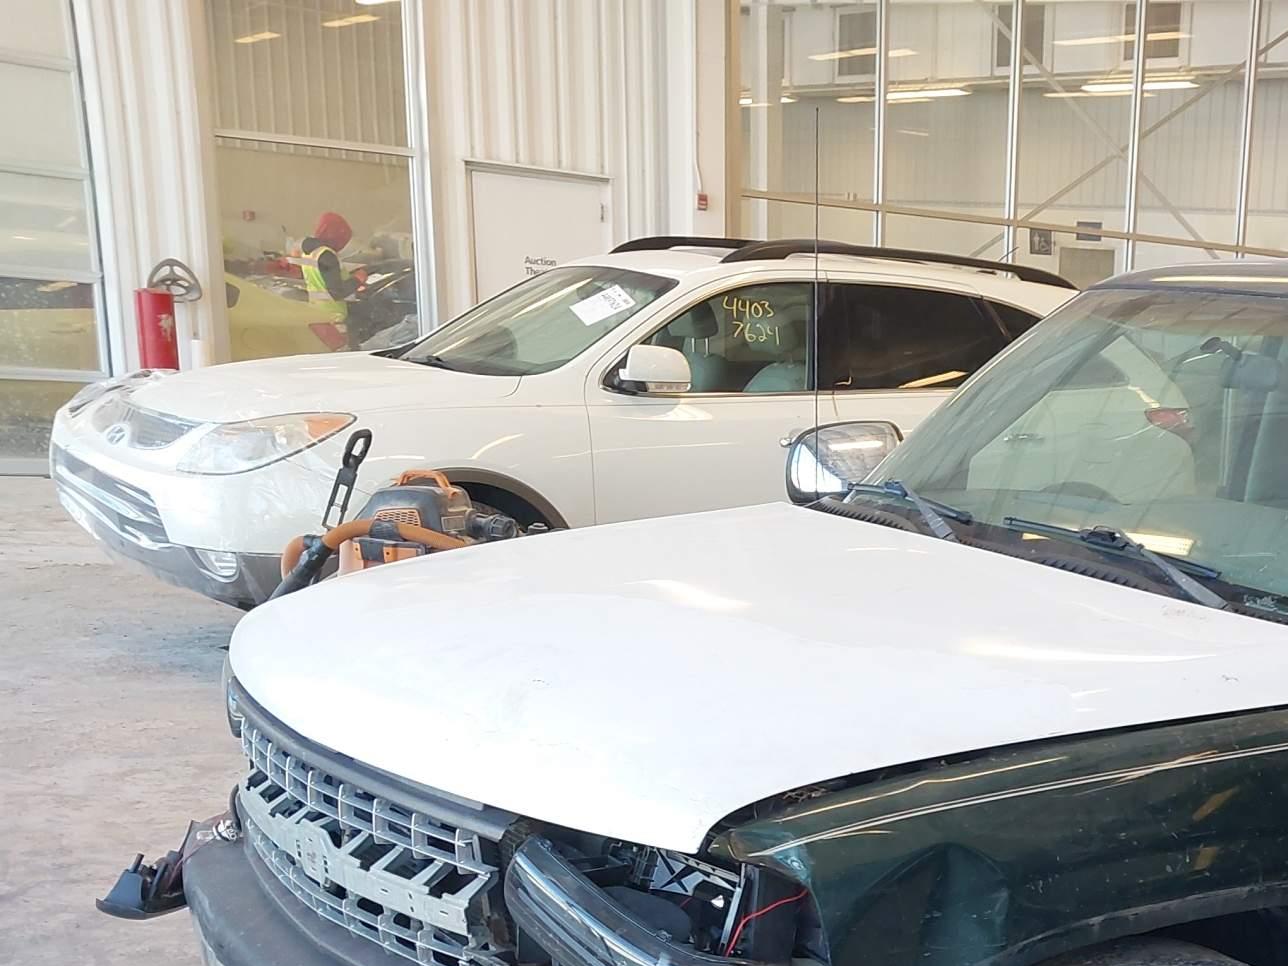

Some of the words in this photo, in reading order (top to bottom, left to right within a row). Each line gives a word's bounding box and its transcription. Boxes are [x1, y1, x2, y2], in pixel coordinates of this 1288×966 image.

[524, 256, 557, 266] Auction
[722, 296, 775, 319] 4403
[732, 321, 780, 346] 7624
